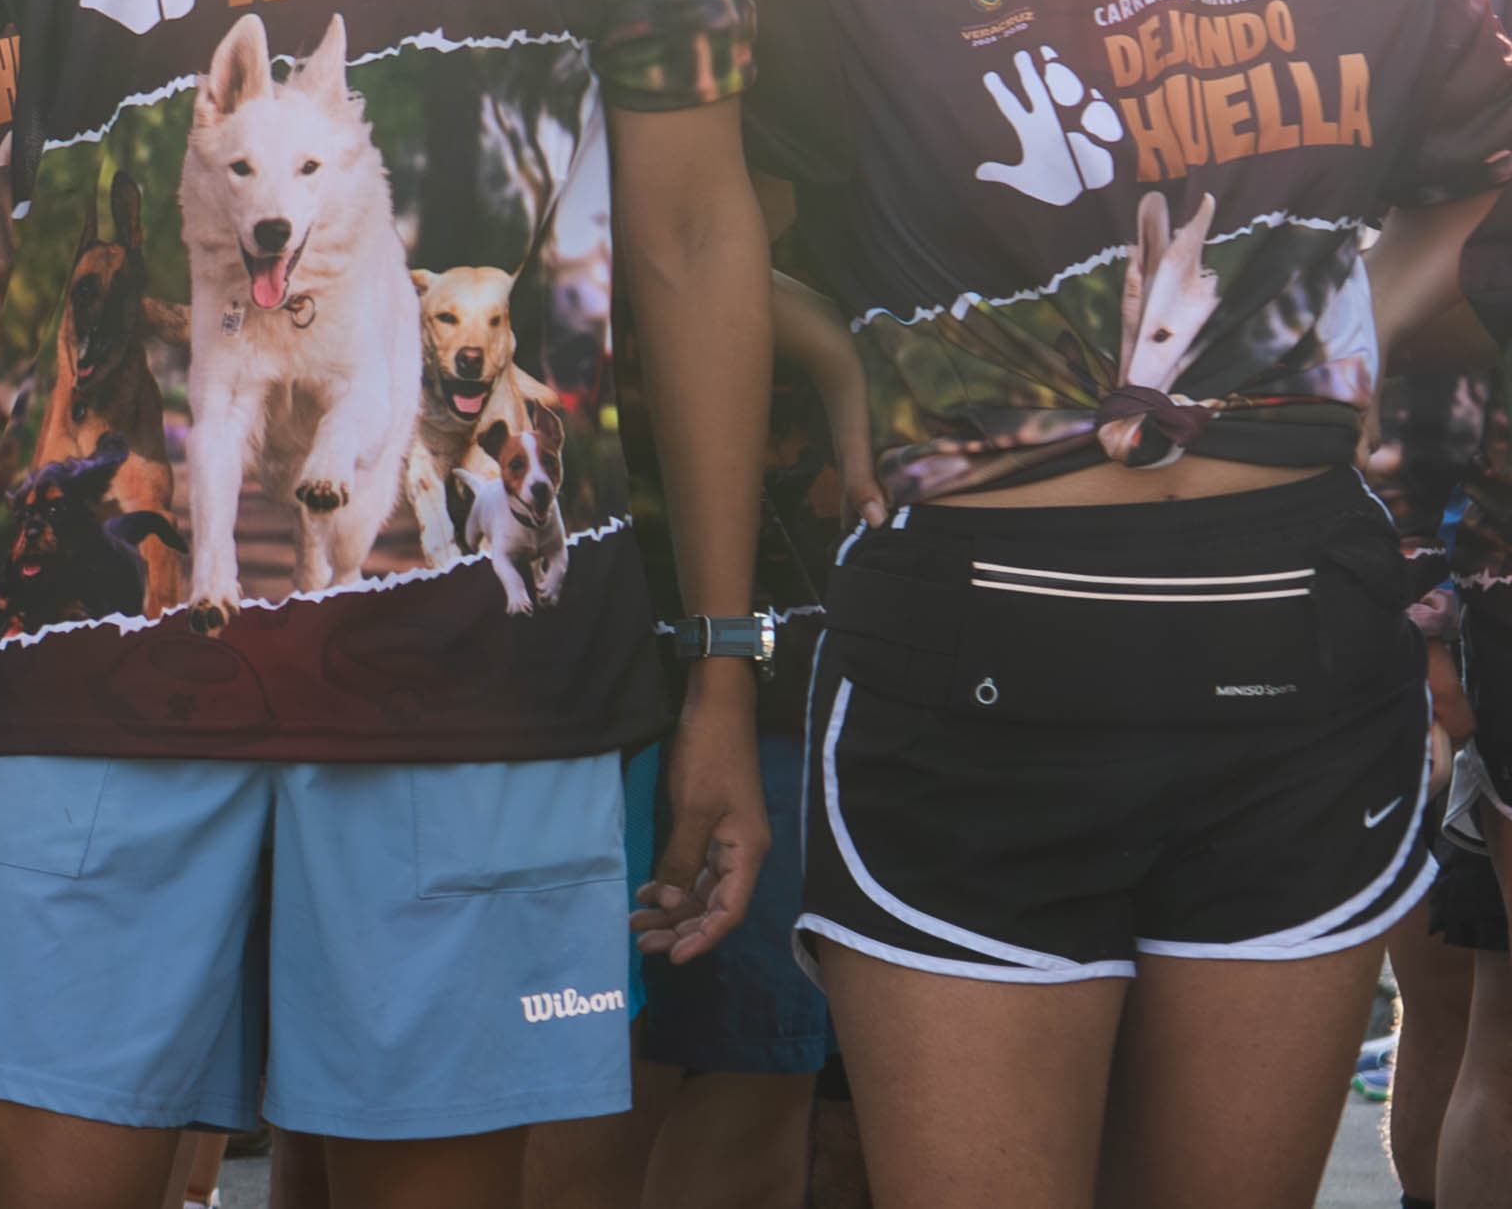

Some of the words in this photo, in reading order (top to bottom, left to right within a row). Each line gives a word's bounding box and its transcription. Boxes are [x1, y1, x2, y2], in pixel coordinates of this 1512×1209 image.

[959, 10, 1036, 41] VERACRUZ
[1103, 0, 1296, 88] DEJANDO
[1118, 53, 1373, 183] HUELLA
[1215, 684, 1264, 696] MINISO
[520, 988, 625, 1023] Wilson
